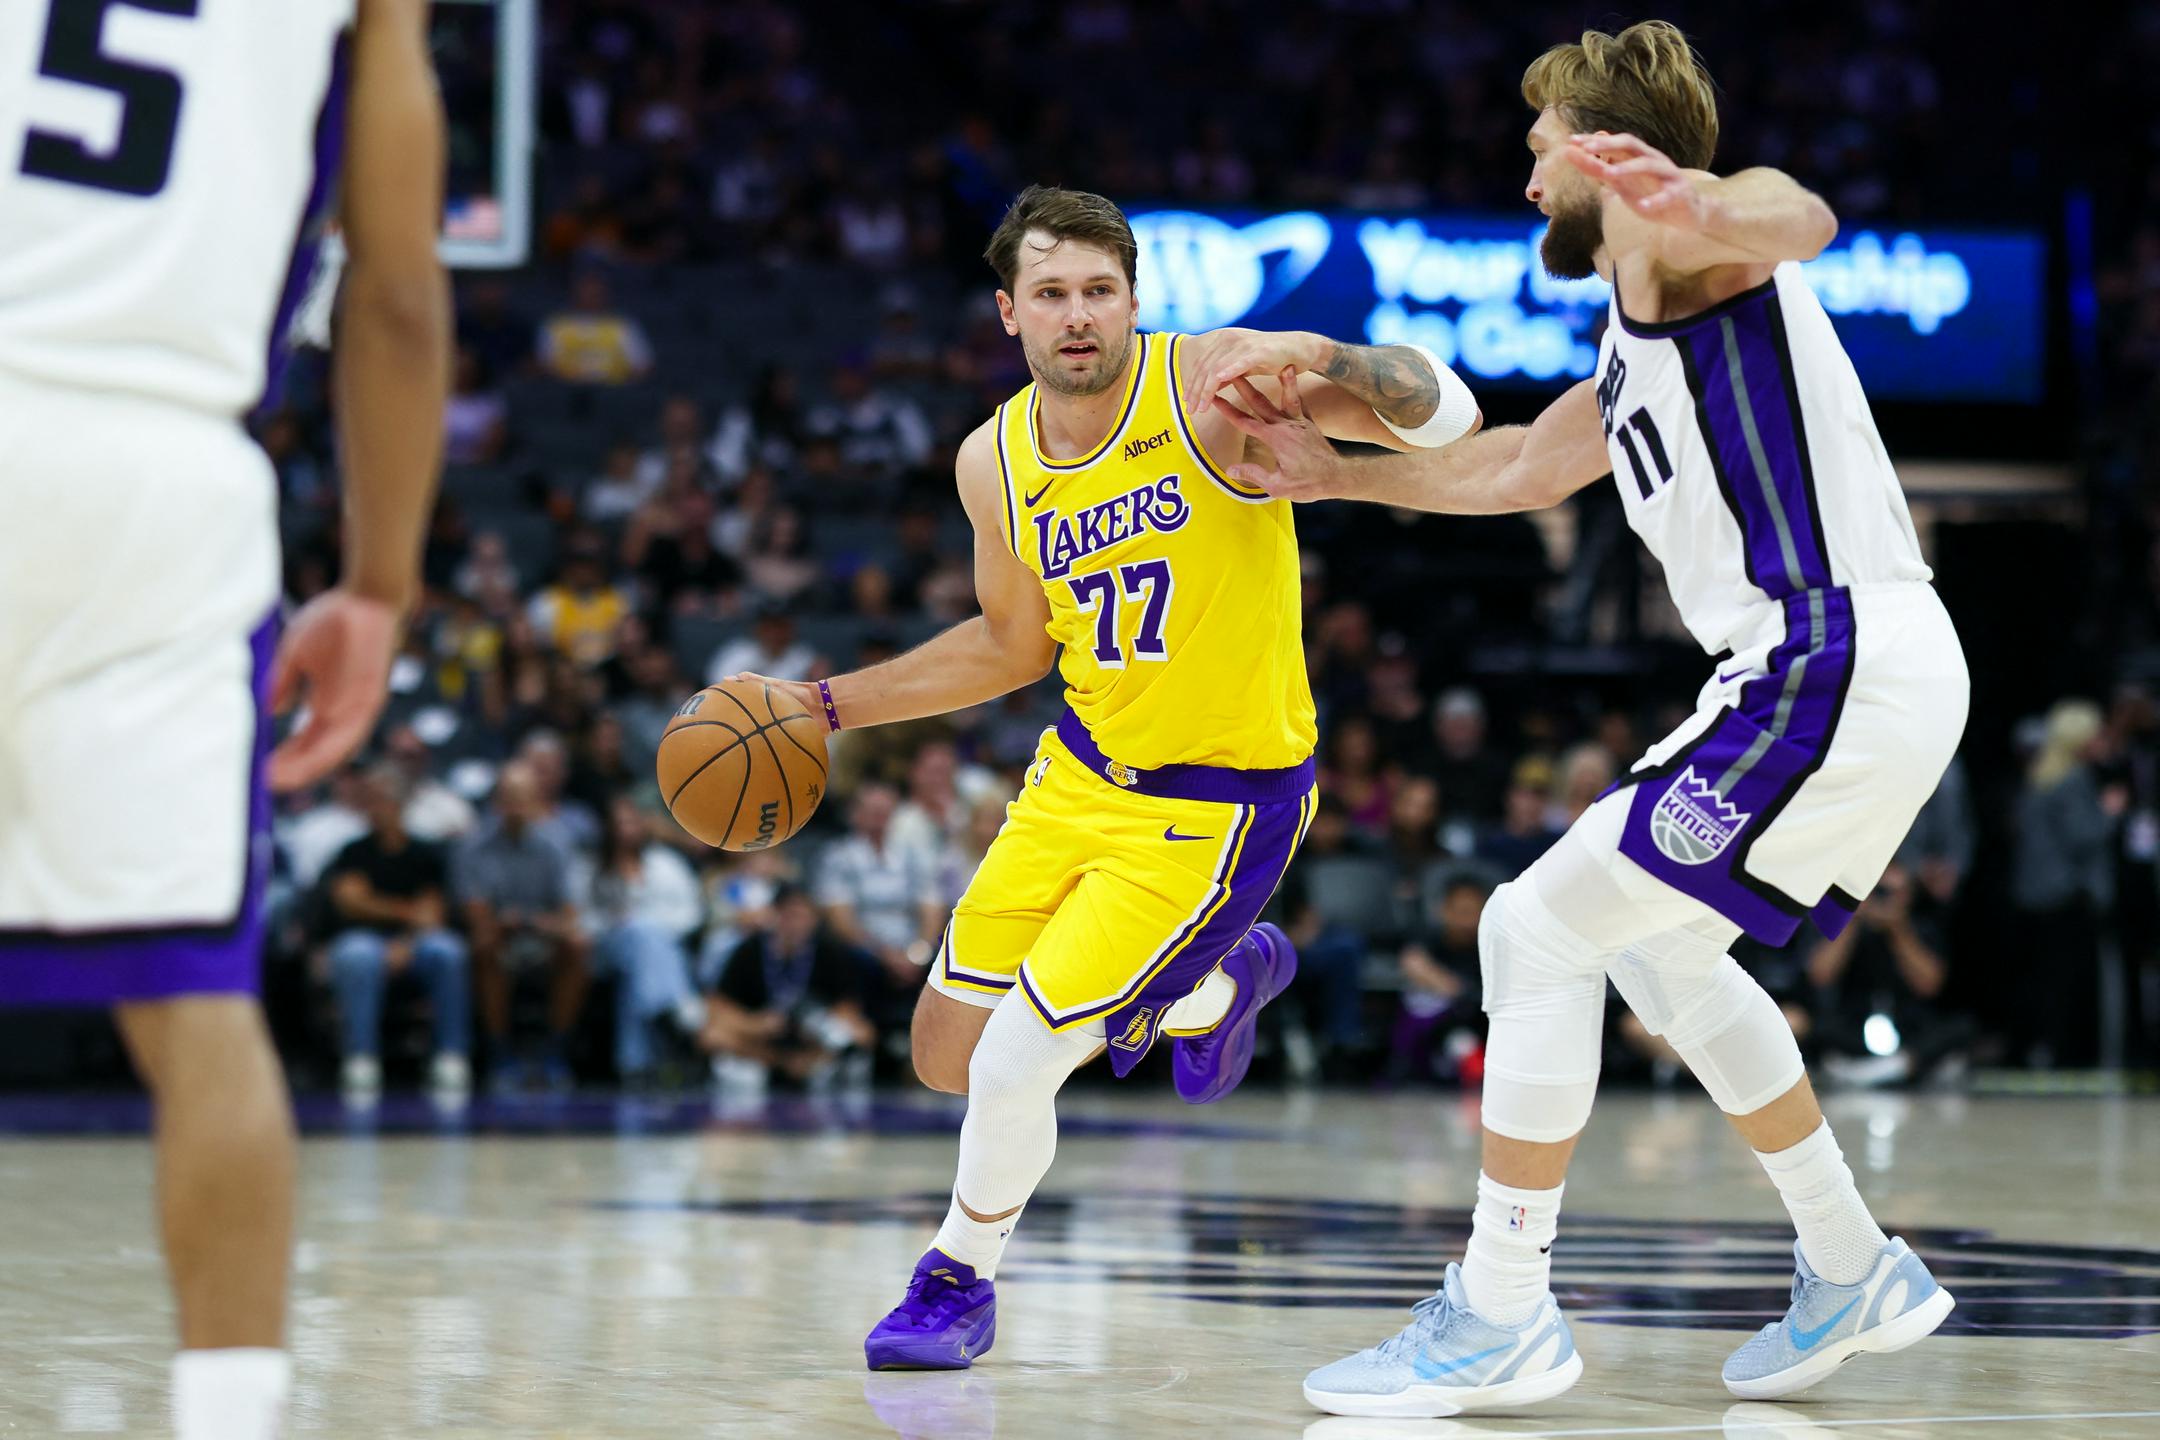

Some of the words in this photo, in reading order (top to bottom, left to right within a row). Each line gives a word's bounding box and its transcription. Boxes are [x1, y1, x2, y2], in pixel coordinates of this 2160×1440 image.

[18, 0, 201, 198] 5
[1357, 217, 1528, 303] Your
[1124, 429, 1173, 461] Albert
[1616, 405, 1674, 501] 11
[1033, 474, 1191, 580] LAKERS
[1068, 557, 1175, 670] 77
[743, 800, 779, 851] lson
[1661, 796, 1726, 851] KINGS
